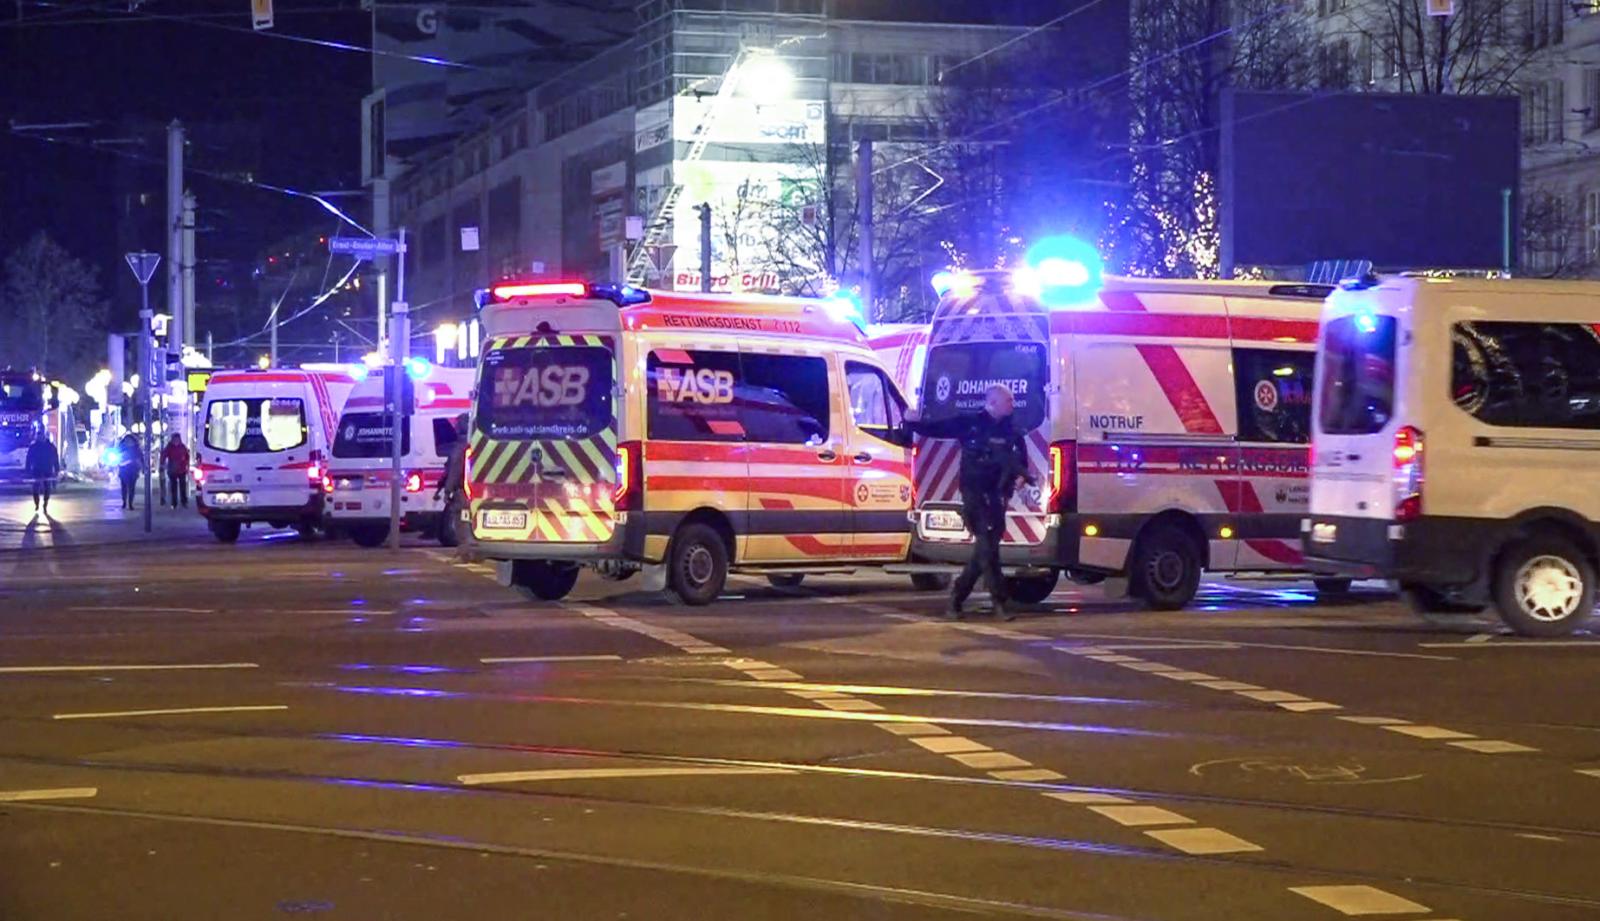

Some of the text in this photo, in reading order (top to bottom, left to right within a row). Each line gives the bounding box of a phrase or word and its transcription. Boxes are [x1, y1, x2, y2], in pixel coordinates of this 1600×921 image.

[416, 9, 437, 34] G
[663, 314, 801, 333] RETTUNGSDIENST 112
[512, 365, 590, 407] ASB
[676, 368, 735, 405] ASB
[1090, 415, 1143, 429] NOTRUF
